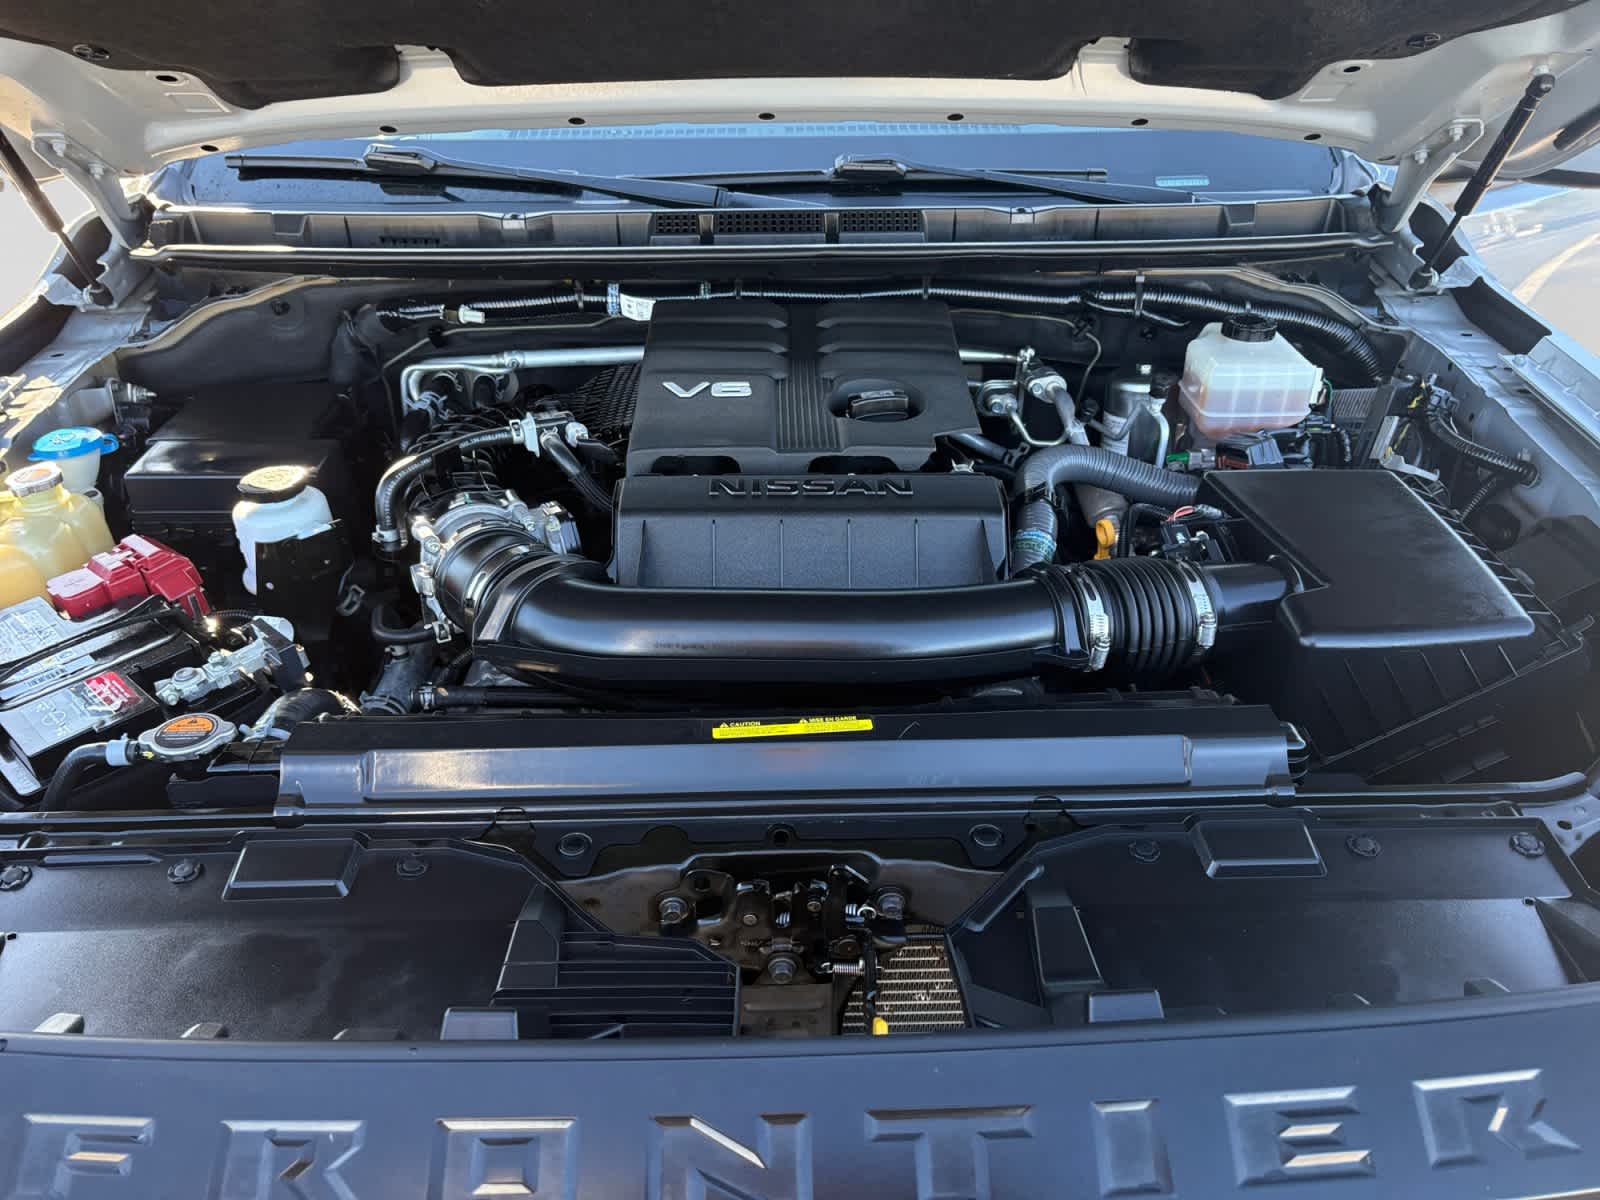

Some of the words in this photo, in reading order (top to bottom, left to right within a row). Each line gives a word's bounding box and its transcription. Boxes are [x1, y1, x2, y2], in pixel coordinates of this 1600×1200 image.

[662, 381, 753, 398] V6
[708, 478, 914, 496] NISSAN
[10, 1069, 1582, 1200] FRONTIER
